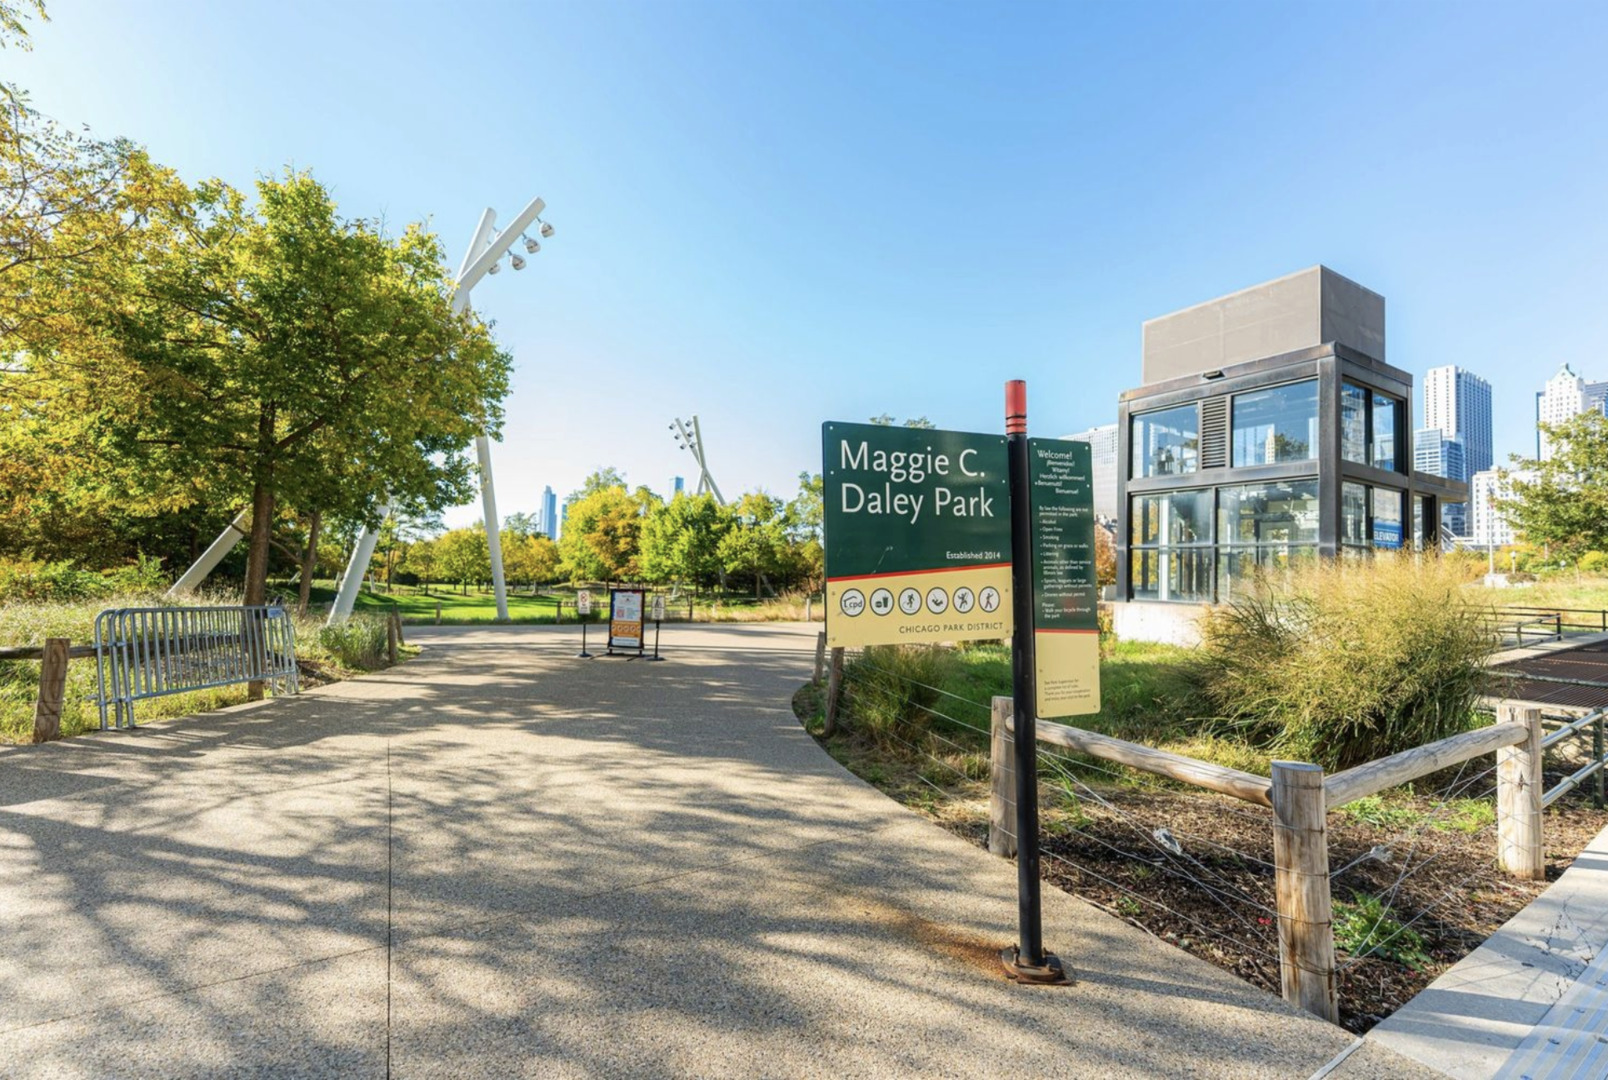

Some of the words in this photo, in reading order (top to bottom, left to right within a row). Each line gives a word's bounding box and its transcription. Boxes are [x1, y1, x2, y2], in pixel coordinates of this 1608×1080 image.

[1037, 449, 1072, 459] Welcome!
[841, 439, 949, 483] Maggie
[959, 448, 985, 477] C.
[842, 482, 924, 525] Daley
[935, 487, 994, 518] Park
[1373, 531, 1399, 542] ELEVATOR
[946, 551, 983, 560] Established
[984, 551, 1001, 559] 2014
[849, 600, 863, 609] cpd
[899, 624, 940, 634] CHICAGO
[967, 622, 1004, 631] DISTRICT
